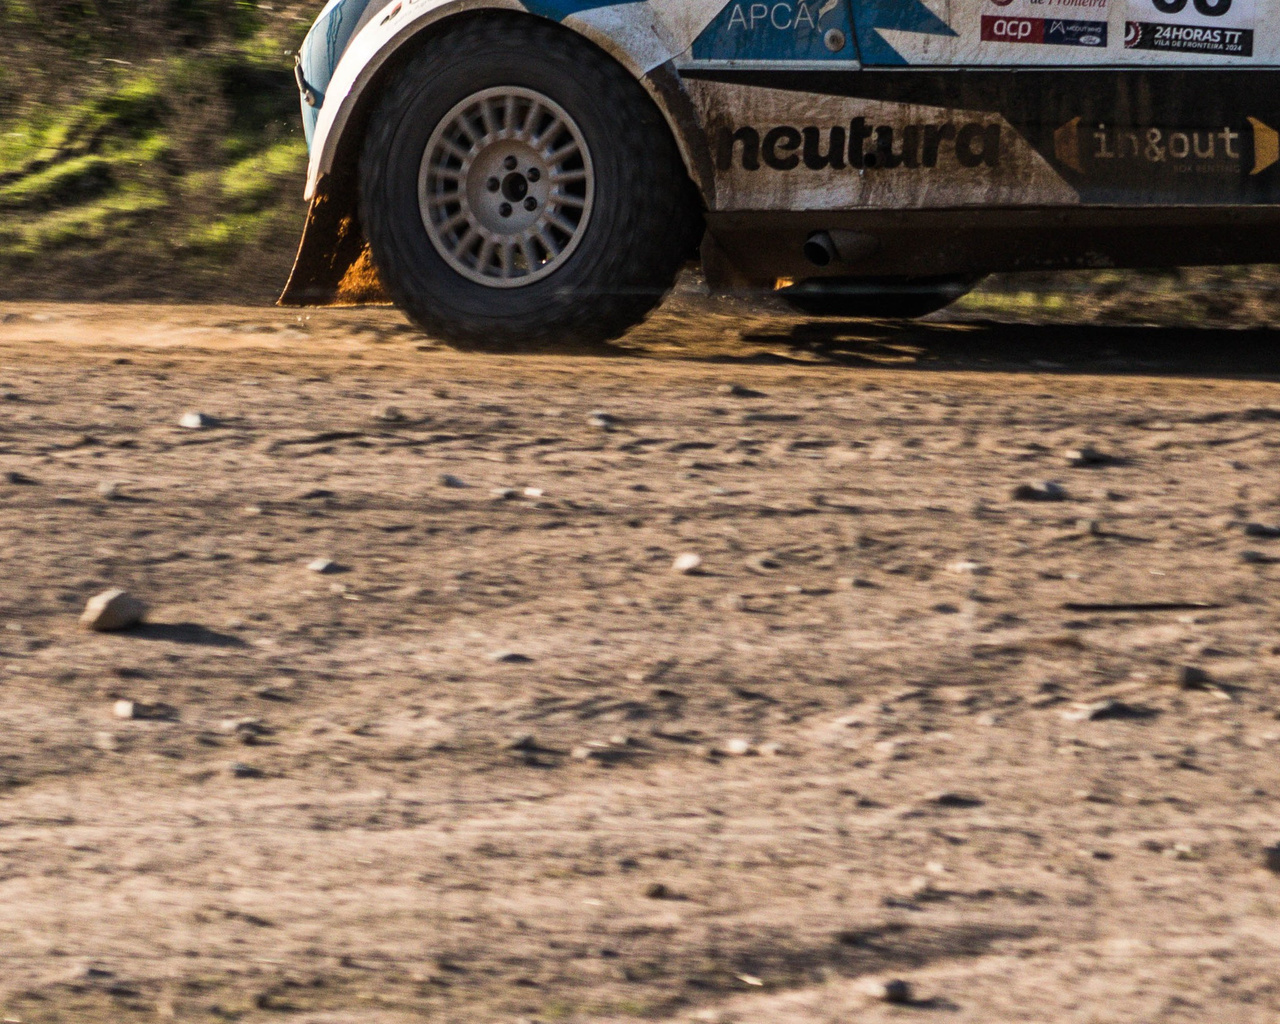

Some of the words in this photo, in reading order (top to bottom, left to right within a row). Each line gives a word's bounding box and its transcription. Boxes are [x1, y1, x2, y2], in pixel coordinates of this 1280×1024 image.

[993, 19, 1032, 39] acp
[1153, 39, 1170, 47] VILA
[1183, 41, 1224, 50] FRONTEIRA
[1225, 44, 1242, 52] 2024
[1224, 31, 1242, 44] TT
[1093, 124, 1240, 162] in&out
